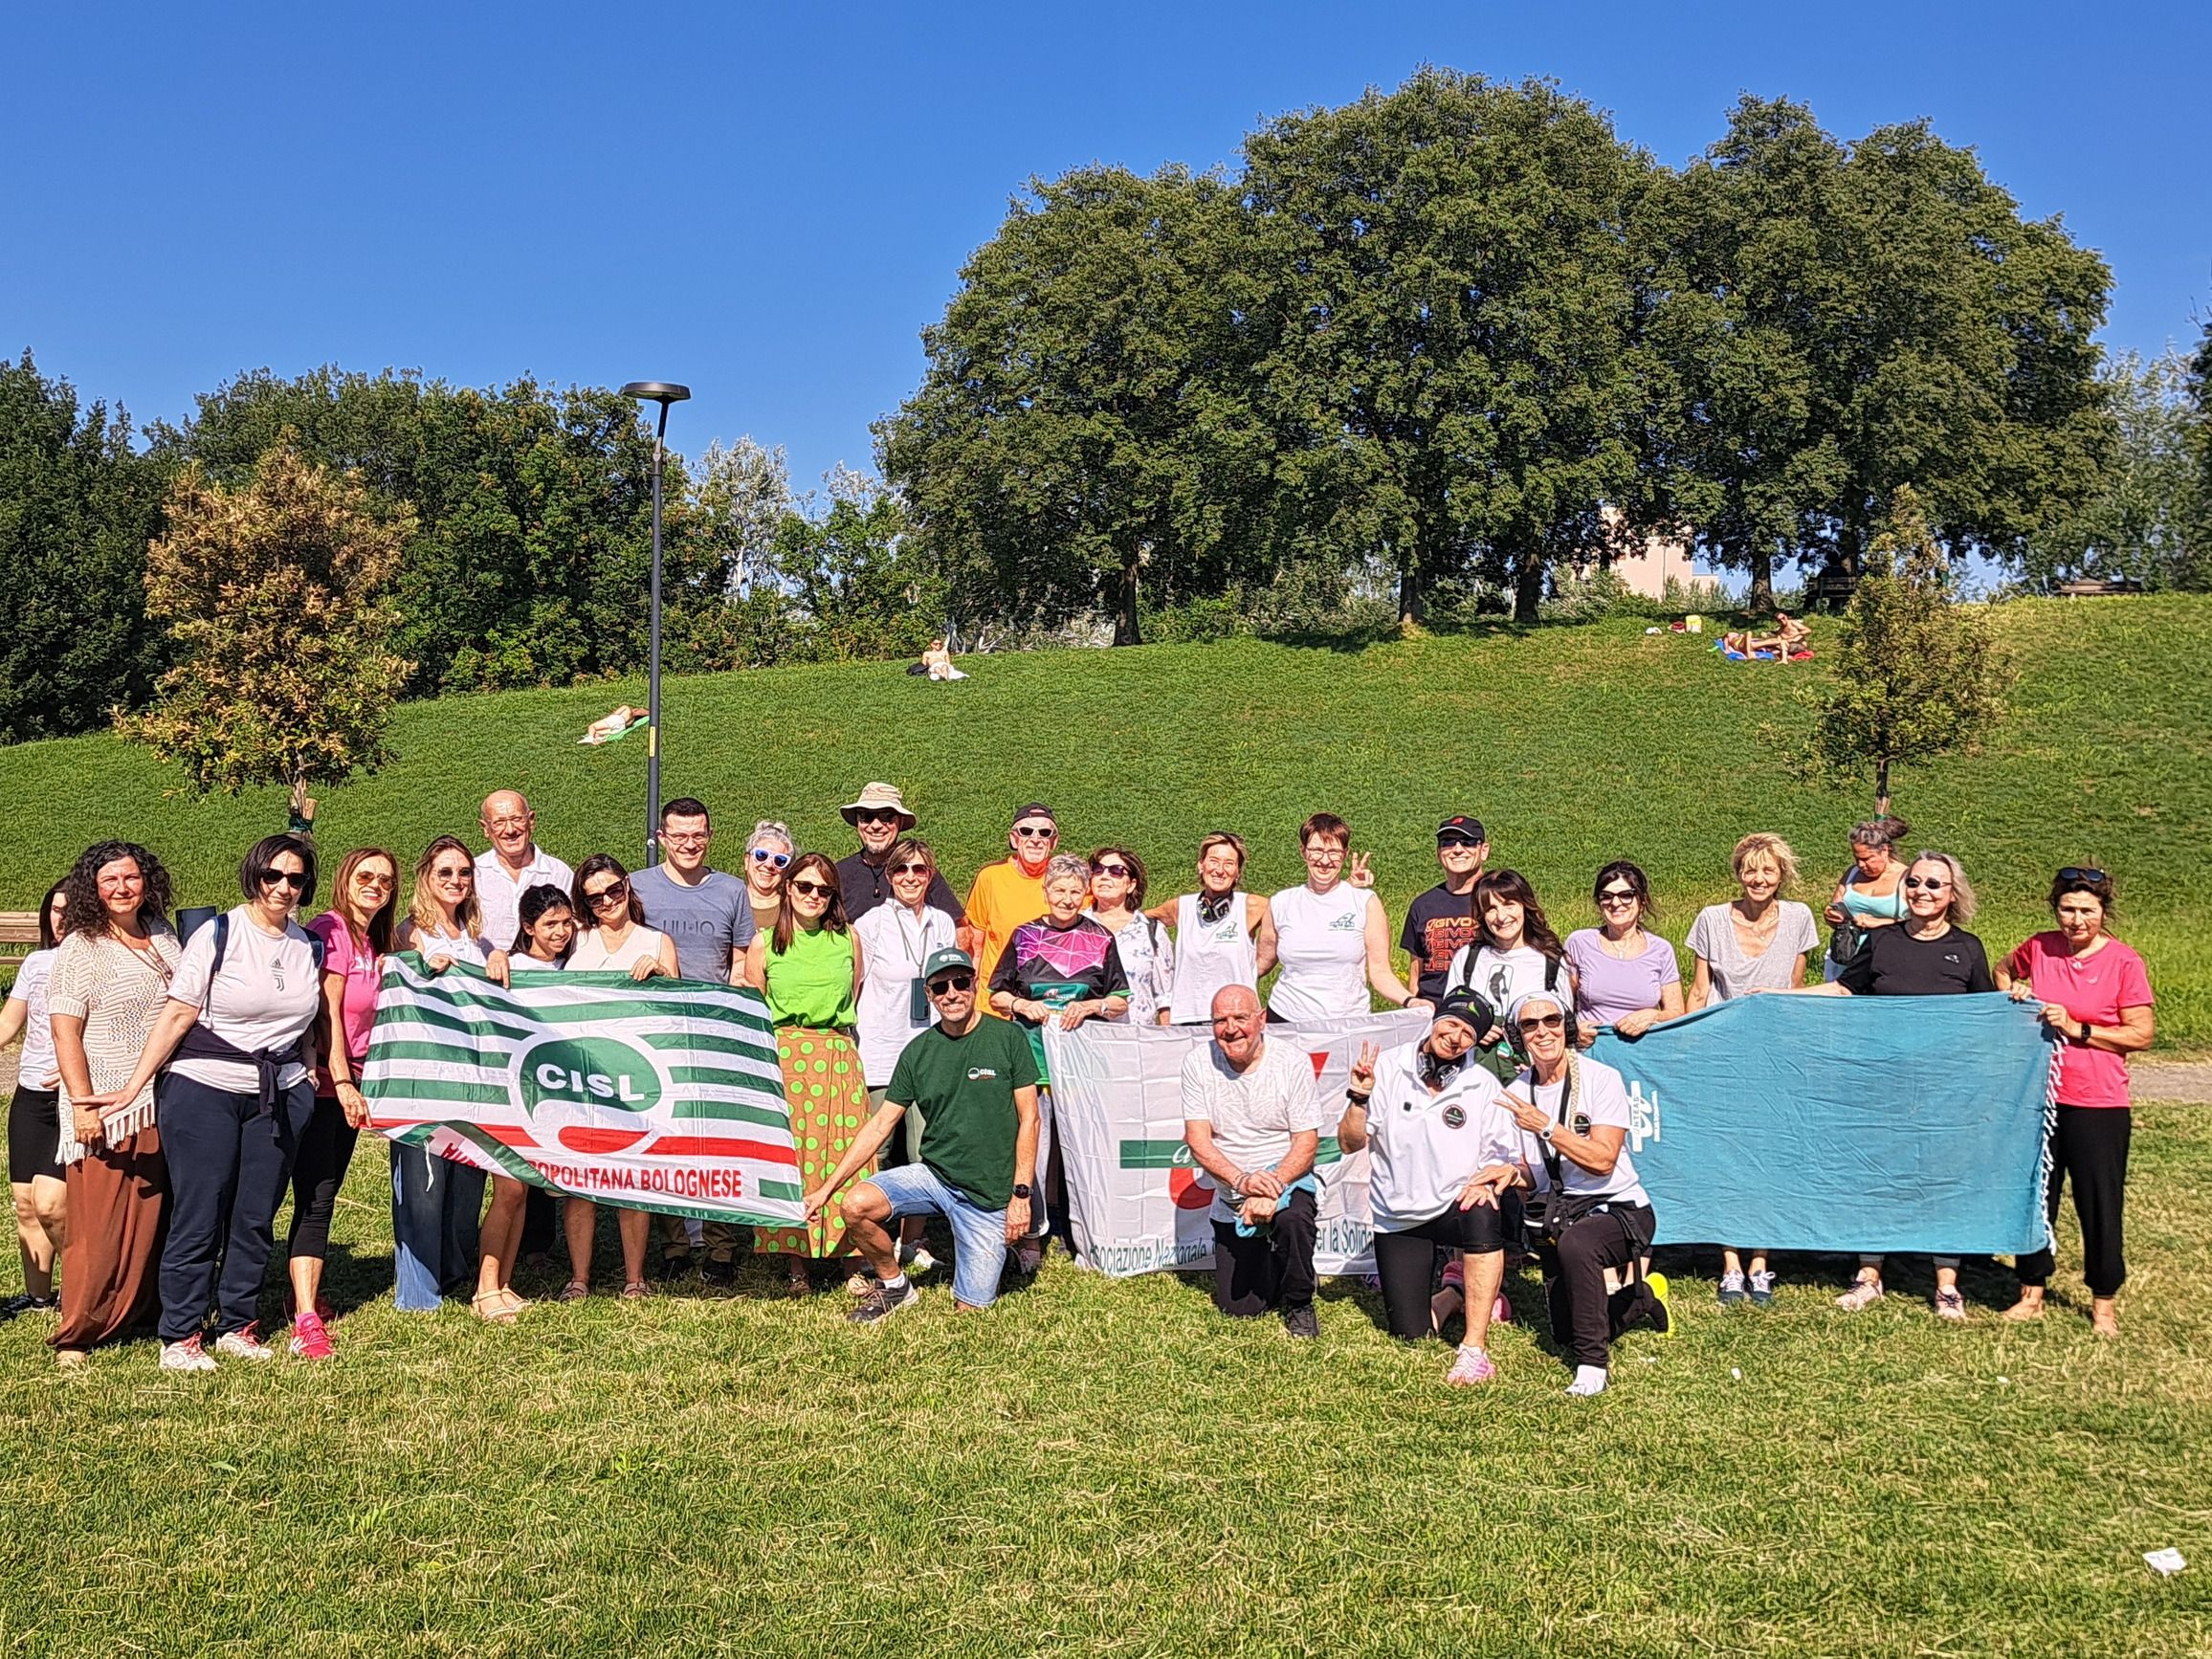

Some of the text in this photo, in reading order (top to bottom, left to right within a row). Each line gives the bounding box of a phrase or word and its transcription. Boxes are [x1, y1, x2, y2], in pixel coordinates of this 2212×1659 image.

[536, 1063, 645, 1102] CISL
[640, 1168, 742, 1198] BOLOGNESE
[1091, 1237, 1153, 1273] sociazione
[1153, 1236, 1207, 1268] Nazionale
[1330, 1219, 1339, 1253] la
